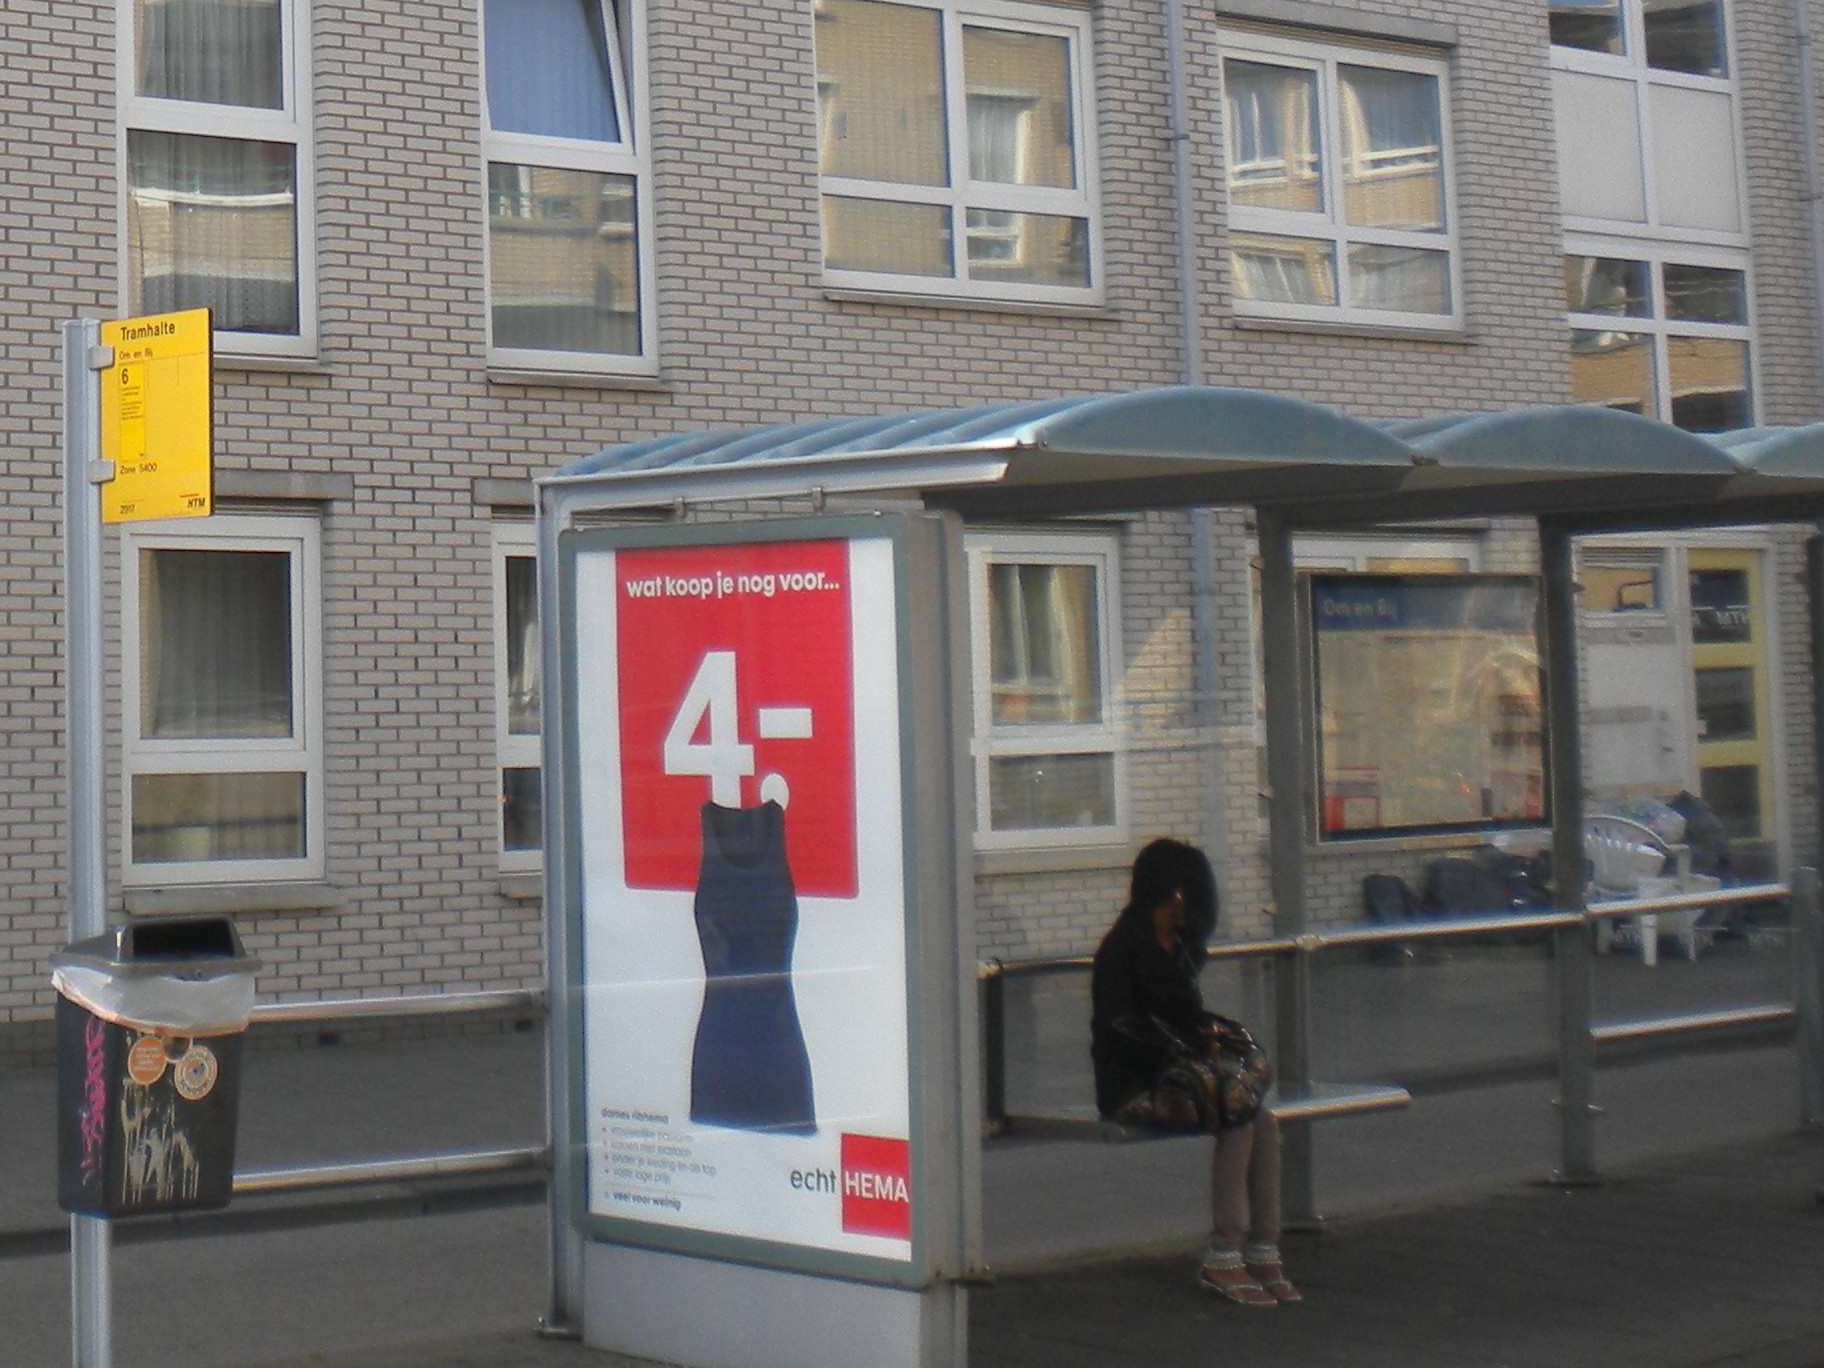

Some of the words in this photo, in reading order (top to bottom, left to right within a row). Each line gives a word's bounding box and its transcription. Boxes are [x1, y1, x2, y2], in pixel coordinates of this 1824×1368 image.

[120, 321, 176, 341] Tramhalte
[121, 368, 129, 384] 6
[187, 497, 206, 509] HTM
[626, 576, 662, 598] wat
[665, 575, 713, 600] koop
[717, 570, 733, 599] je
[738, 574, 775, 598] nog
[779, 571, 840, 591] voor...
[790, 1168, 836, 1194] echt
[844, 1170, 909, 1203] HEMA
